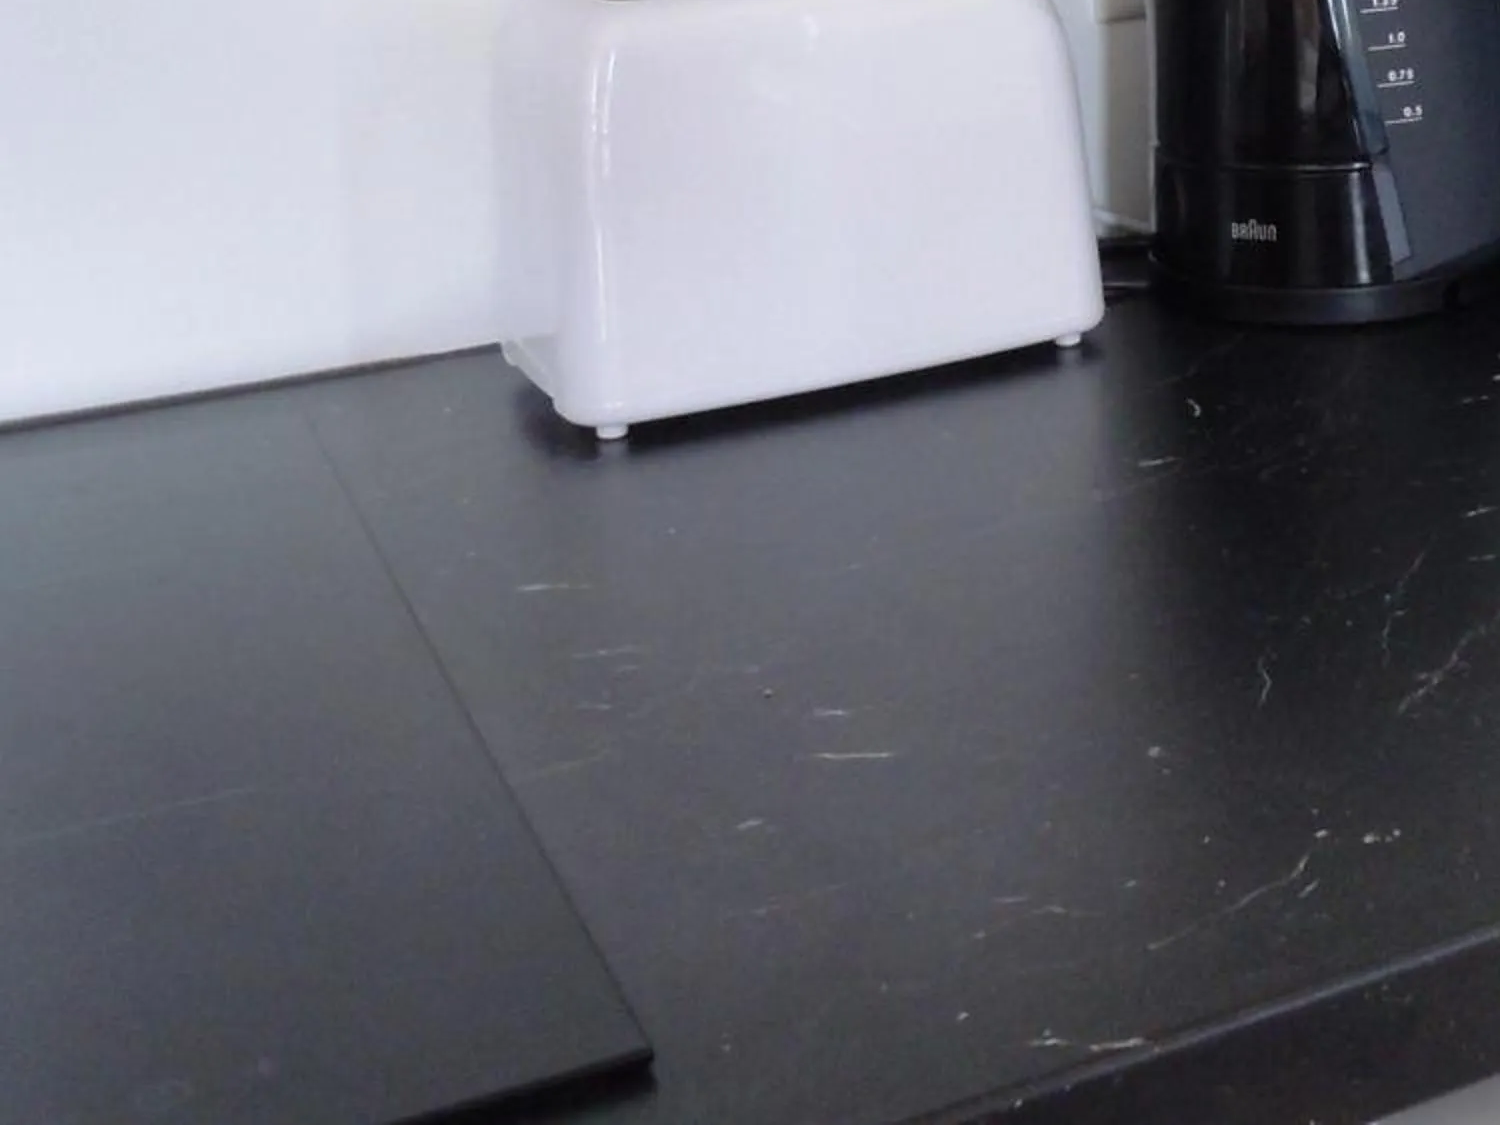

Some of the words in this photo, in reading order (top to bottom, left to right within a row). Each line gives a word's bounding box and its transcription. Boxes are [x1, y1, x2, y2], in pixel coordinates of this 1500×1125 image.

[1388, 31, 1406, 43] 1.0
[1387, 68, 1415, 81] 0.75
[1403, 105, 1423, 117] 0.5
[1231, 218, 1278, 242] BRAUN
